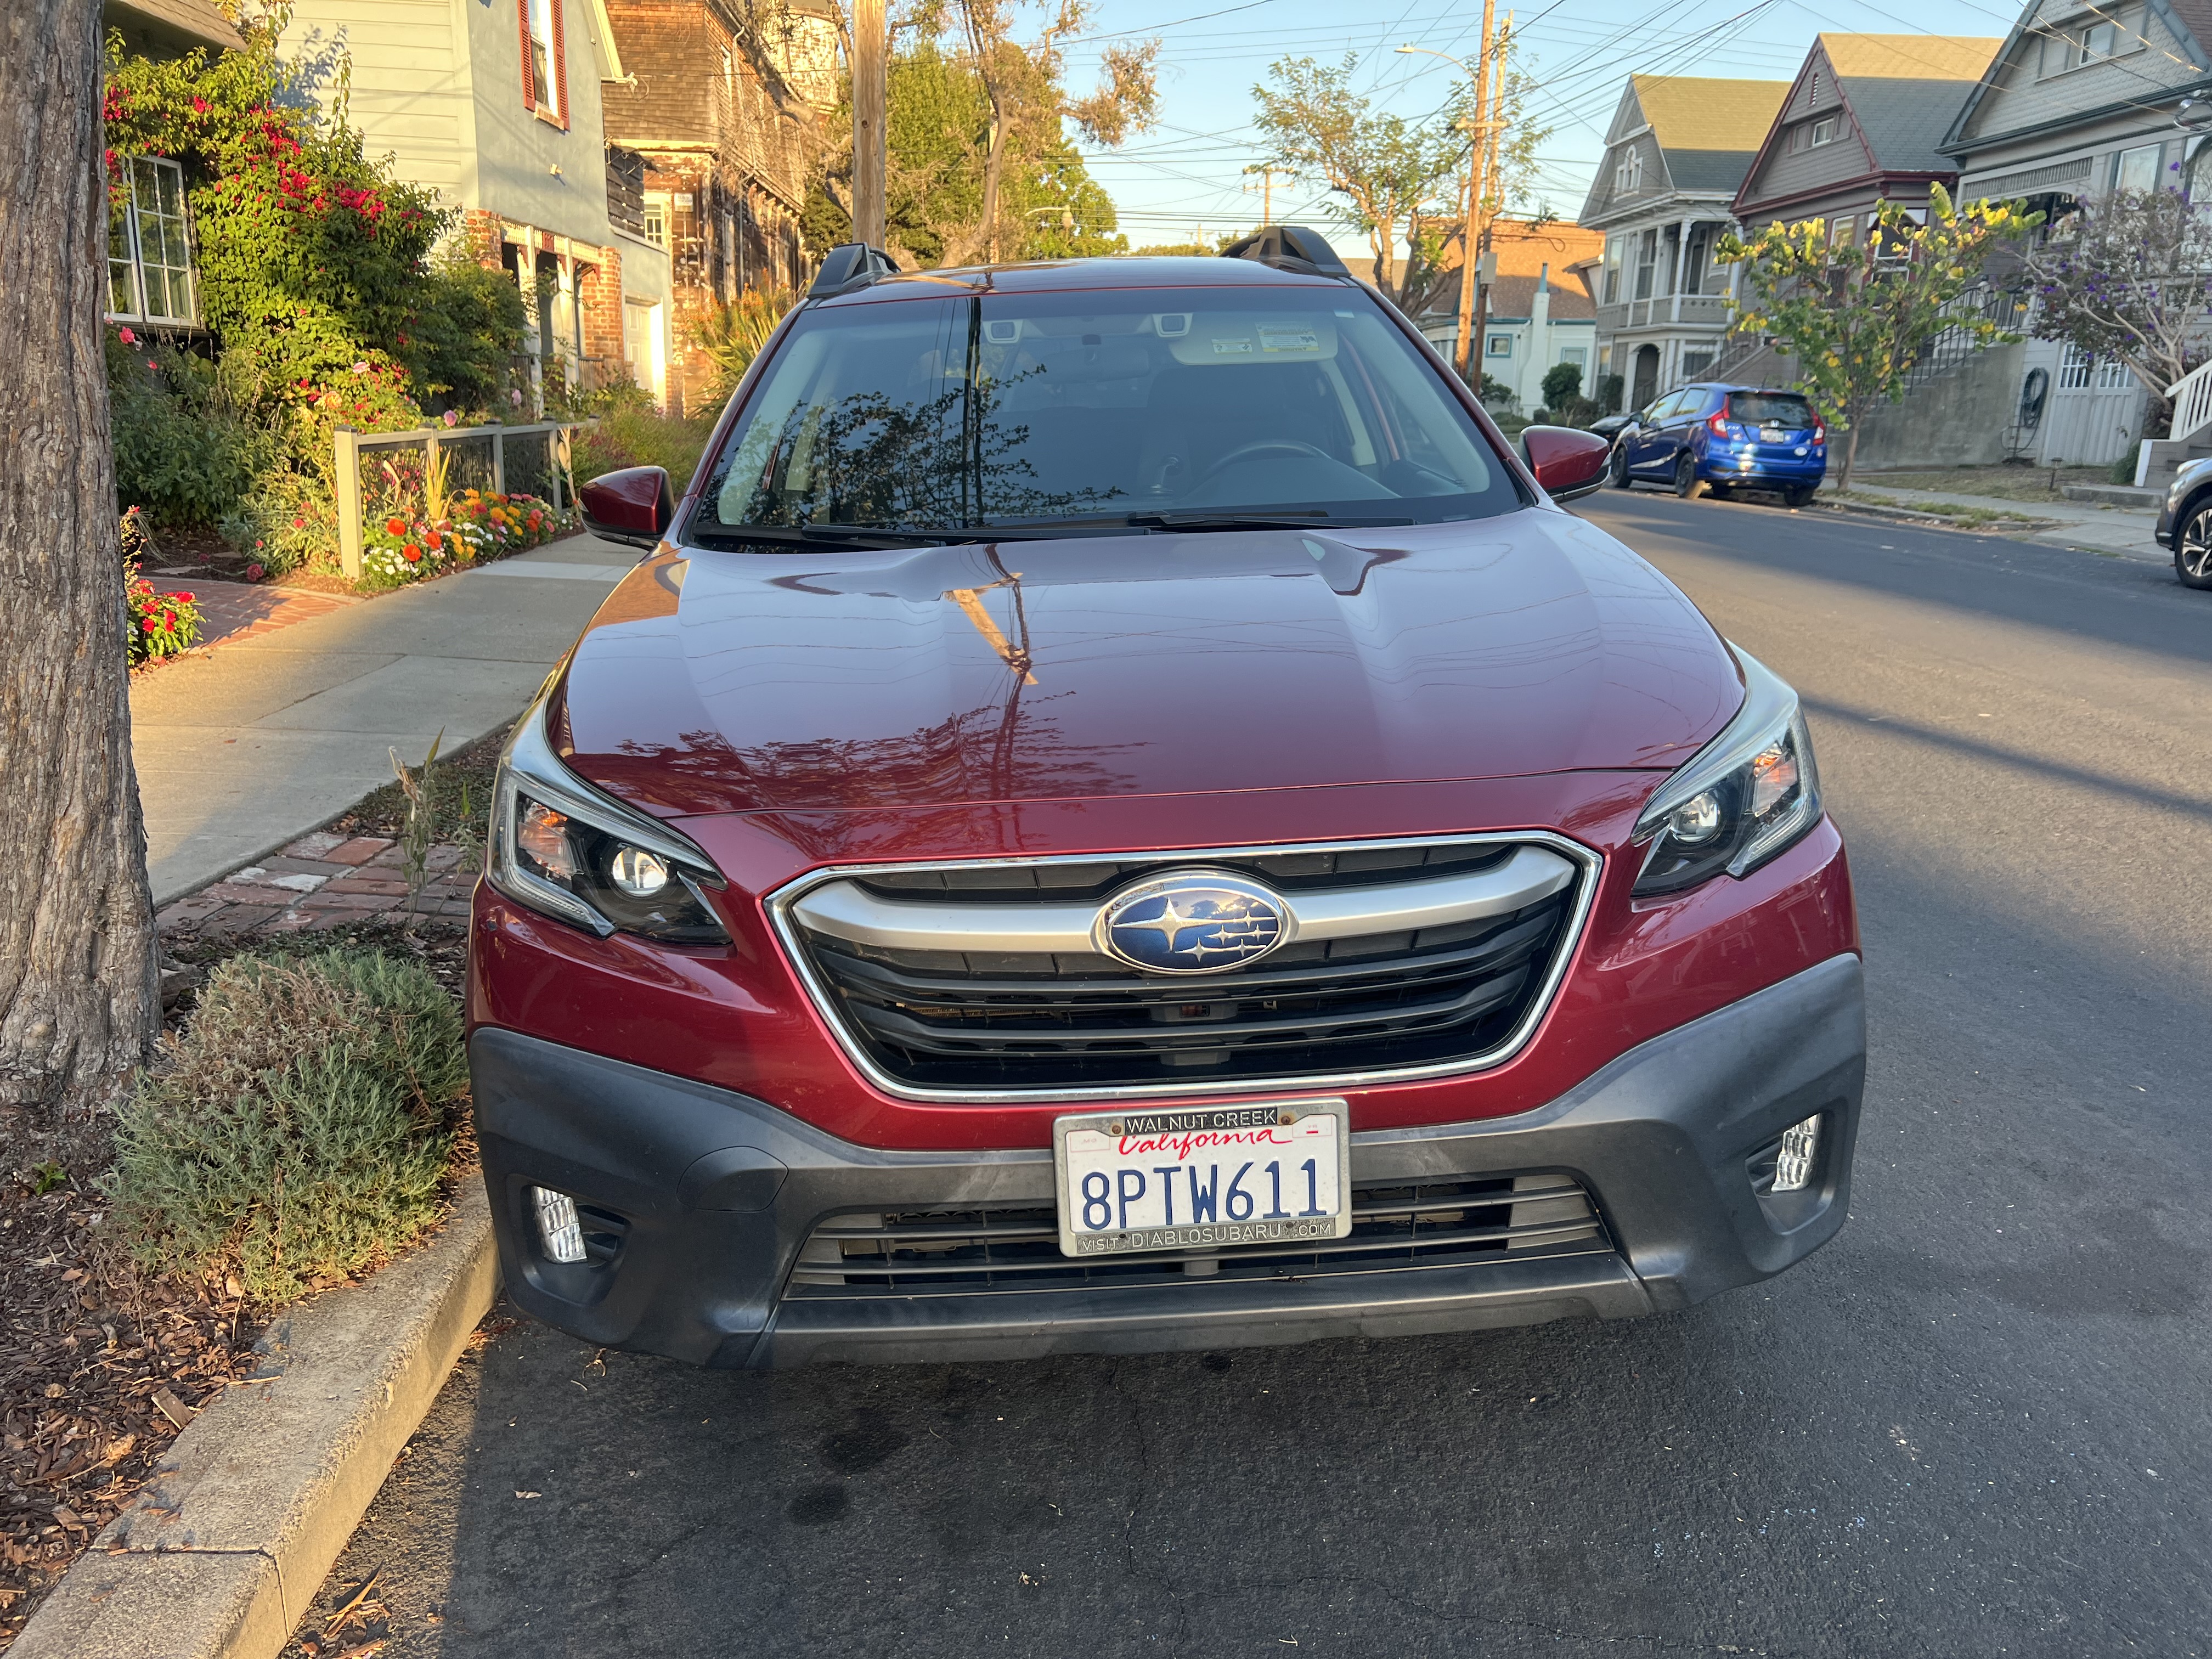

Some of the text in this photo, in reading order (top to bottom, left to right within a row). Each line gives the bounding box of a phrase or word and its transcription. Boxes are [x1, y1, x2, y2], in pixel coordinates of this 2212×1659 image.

[1126, 1109, 1276, 1133] WALNUT CREEK
[1119, 1129, 1293, 1160] California
[1082, 1159, 1327, 1230] 8PTW611
[1082, 1223, 1331, 1251] VISIT DIABLOSUBARU .COM
